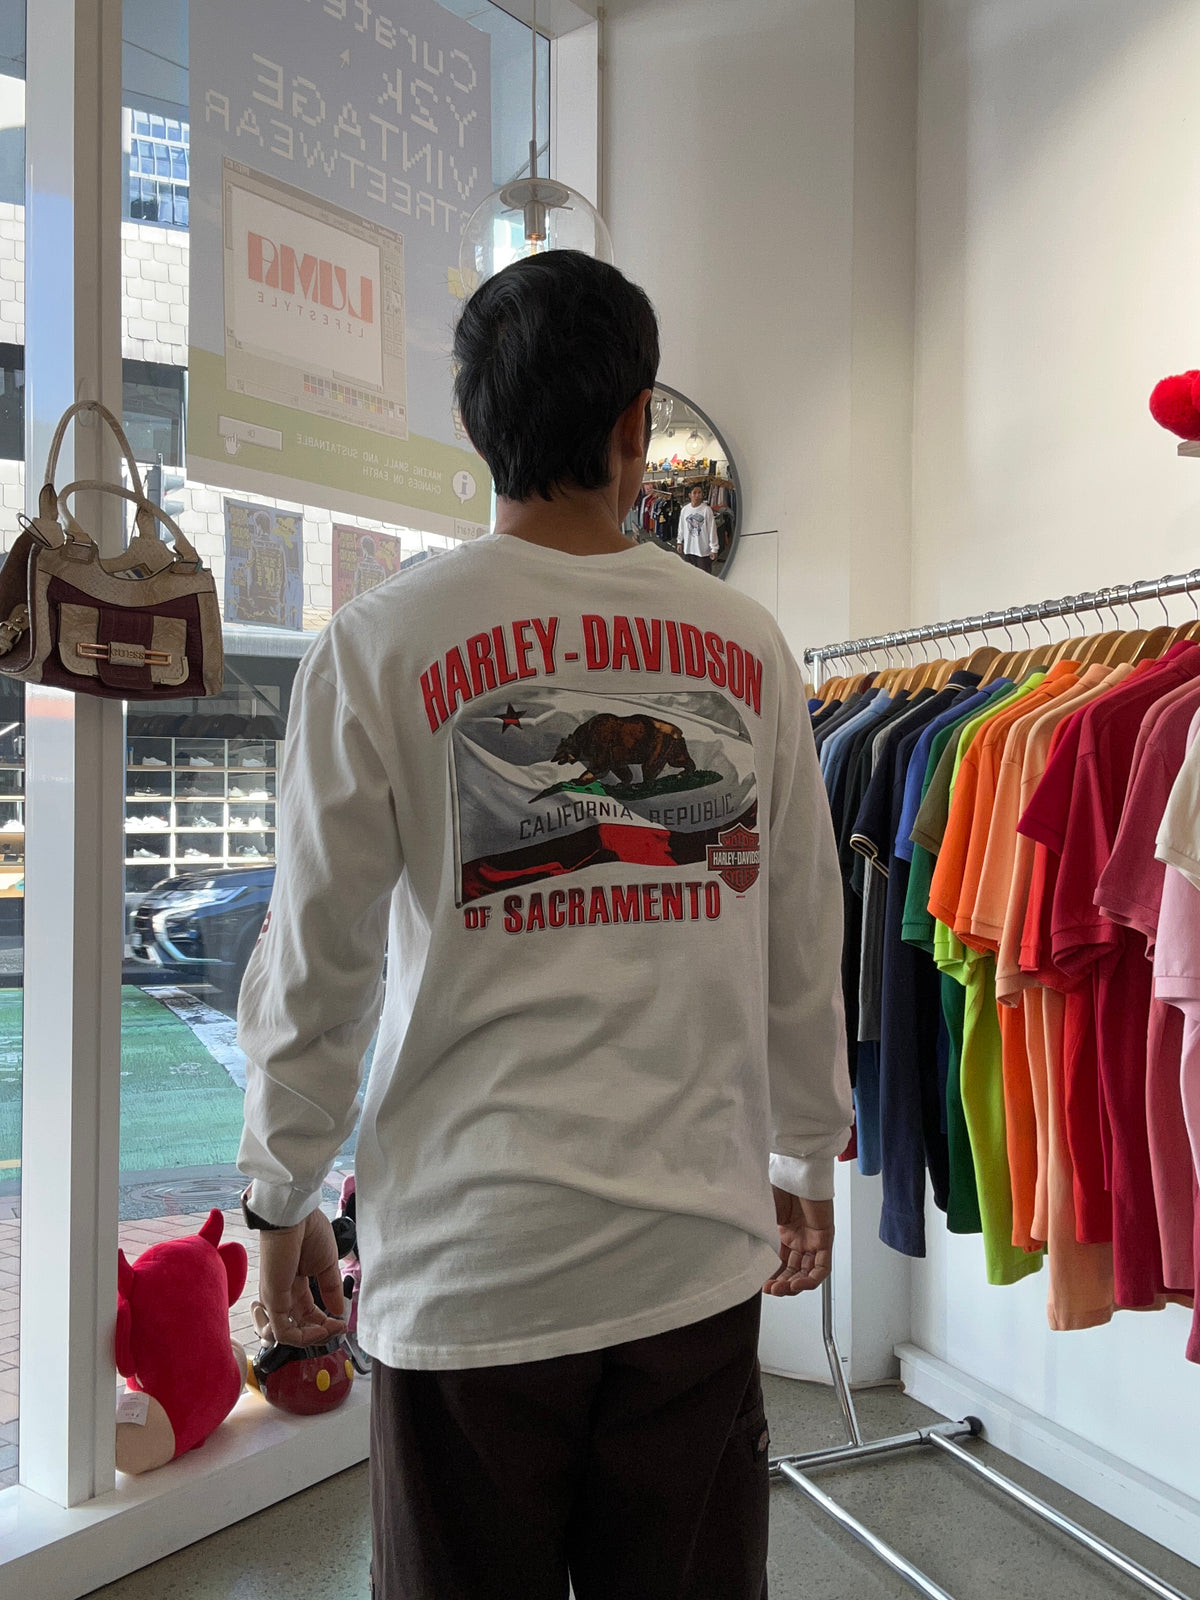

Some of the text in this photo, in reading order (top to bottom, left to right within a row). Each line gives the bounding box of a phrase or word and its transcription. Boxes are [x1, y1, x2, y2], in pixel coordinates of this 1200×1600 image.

[111, 647, 145, 660] GUESS
[419, 614, 763, 735] HARLEY-DAVIDSON
[520, 793, 735, 841] CALIFORNIA REPUBLIC
[726, 869, 755, 888] CYCLES
[463, 880, 721, 934] OF SACRAMENTO
